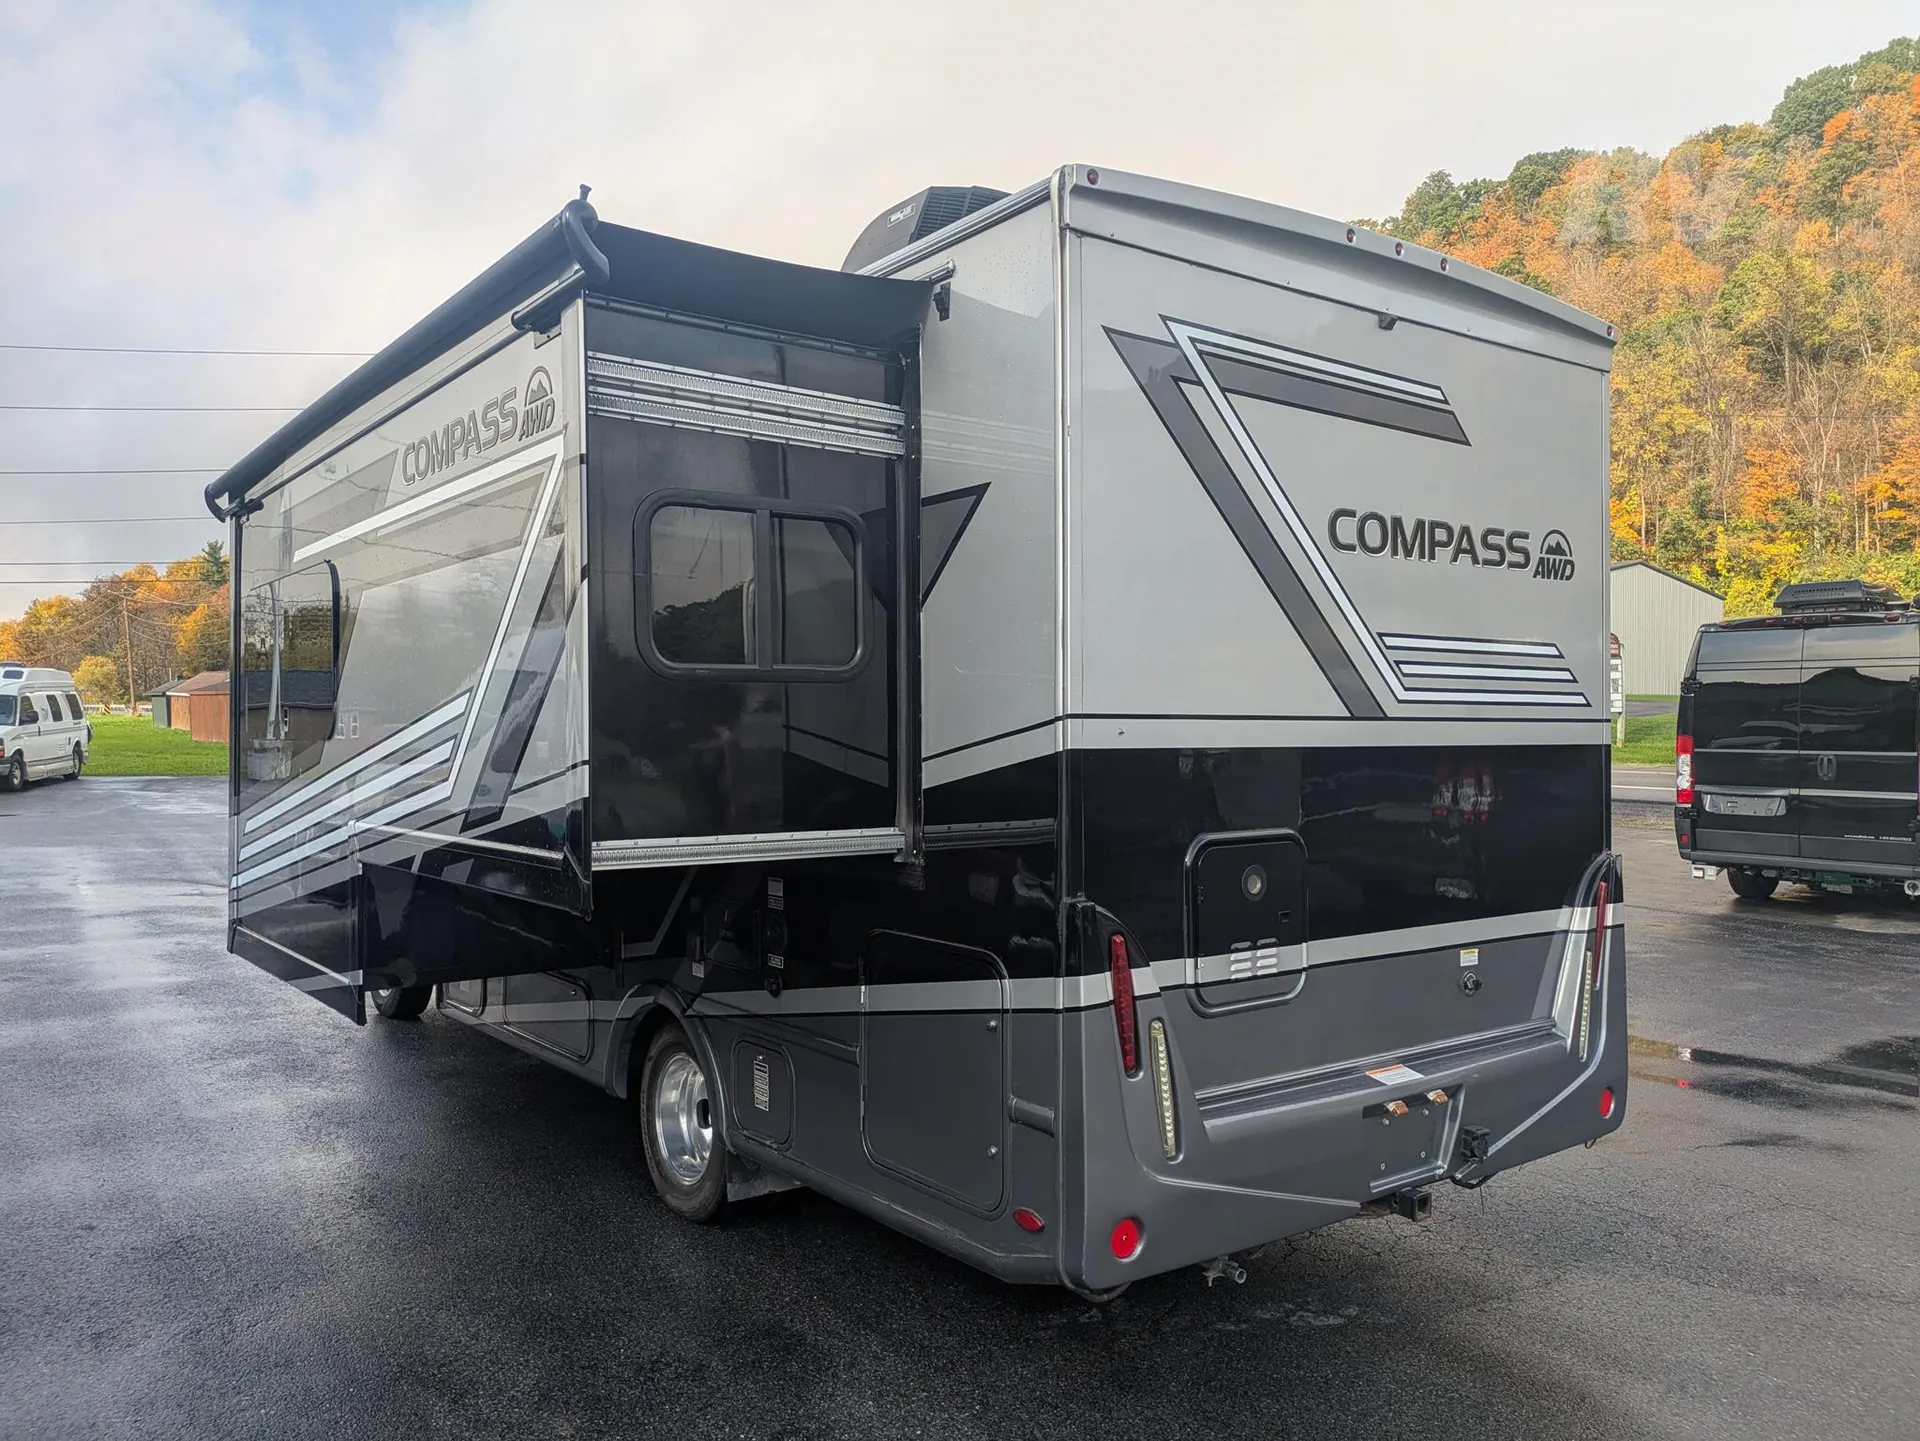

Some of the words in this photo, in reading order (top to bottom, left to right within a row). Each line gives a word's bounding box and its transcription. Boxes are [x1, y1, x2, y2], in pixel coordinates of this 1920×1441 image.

[402, 387, 518, 486] COMPASS
[518, 397, 556, 442] AWD
[1327, 507, 1532, 571] COMPASS
[1532, 556, 1576, 582] AWD
